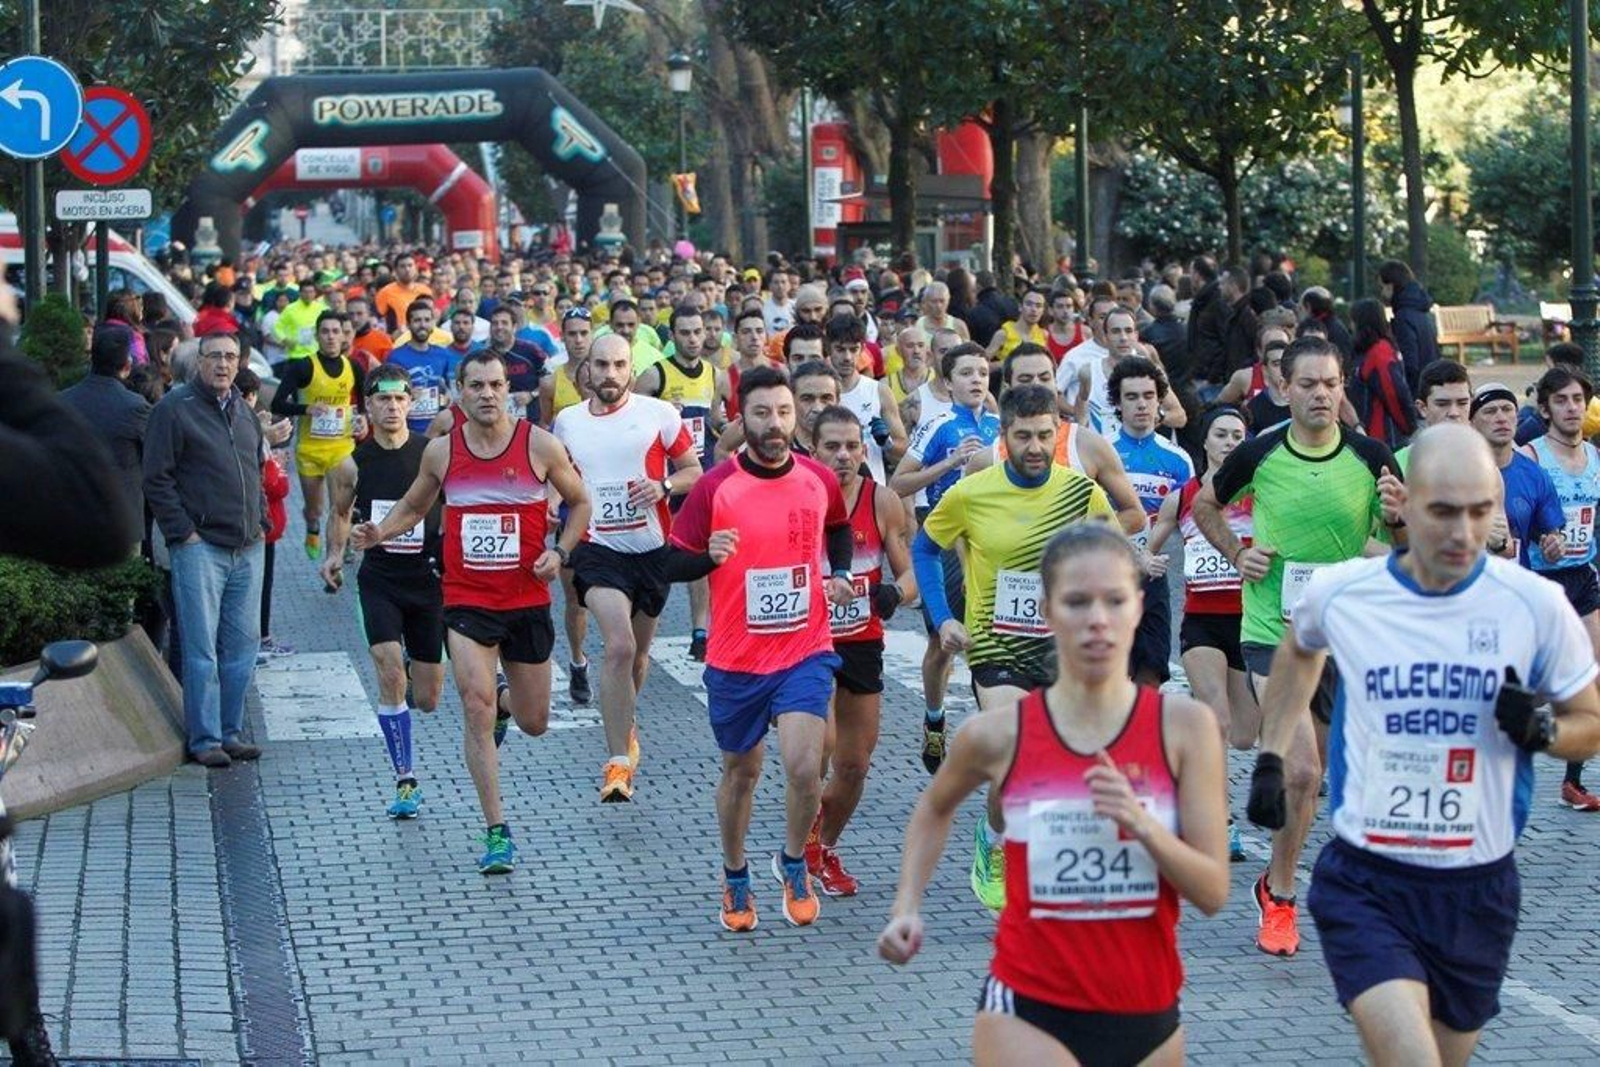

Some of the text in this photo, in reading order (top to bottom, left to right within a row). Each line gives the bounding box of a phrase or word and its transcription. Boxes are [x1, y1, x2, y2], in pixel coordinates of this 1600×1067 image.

[318, 94, 496, 121] POWERADE
[83, 192, 126, 203] INCLUSO
[62, 204, 146, 216] MOTOS EN ACERA
[602, 501, 637, 519] 219
[471, 535, 509, 553] 237
[1195, 556, 1231, 574] 235
[753, 573, 788, 581] CONCELLO
[760, 592, 800, 614] 327
[1011, 597, 1041, 618] 13
[1366, 662, 1497, 702] ATLETISMO
[1386, 708, 1478, 735] BEADE
[1379, 750, 1439, 763] CONCELLO
[1384, 762, 1432, 774] DE VIGO
[1388, 785, 1462, 822] 216
[1380, 819, 1430, 832] CARREIRA
[1055, 847, 1134, 882] 234
